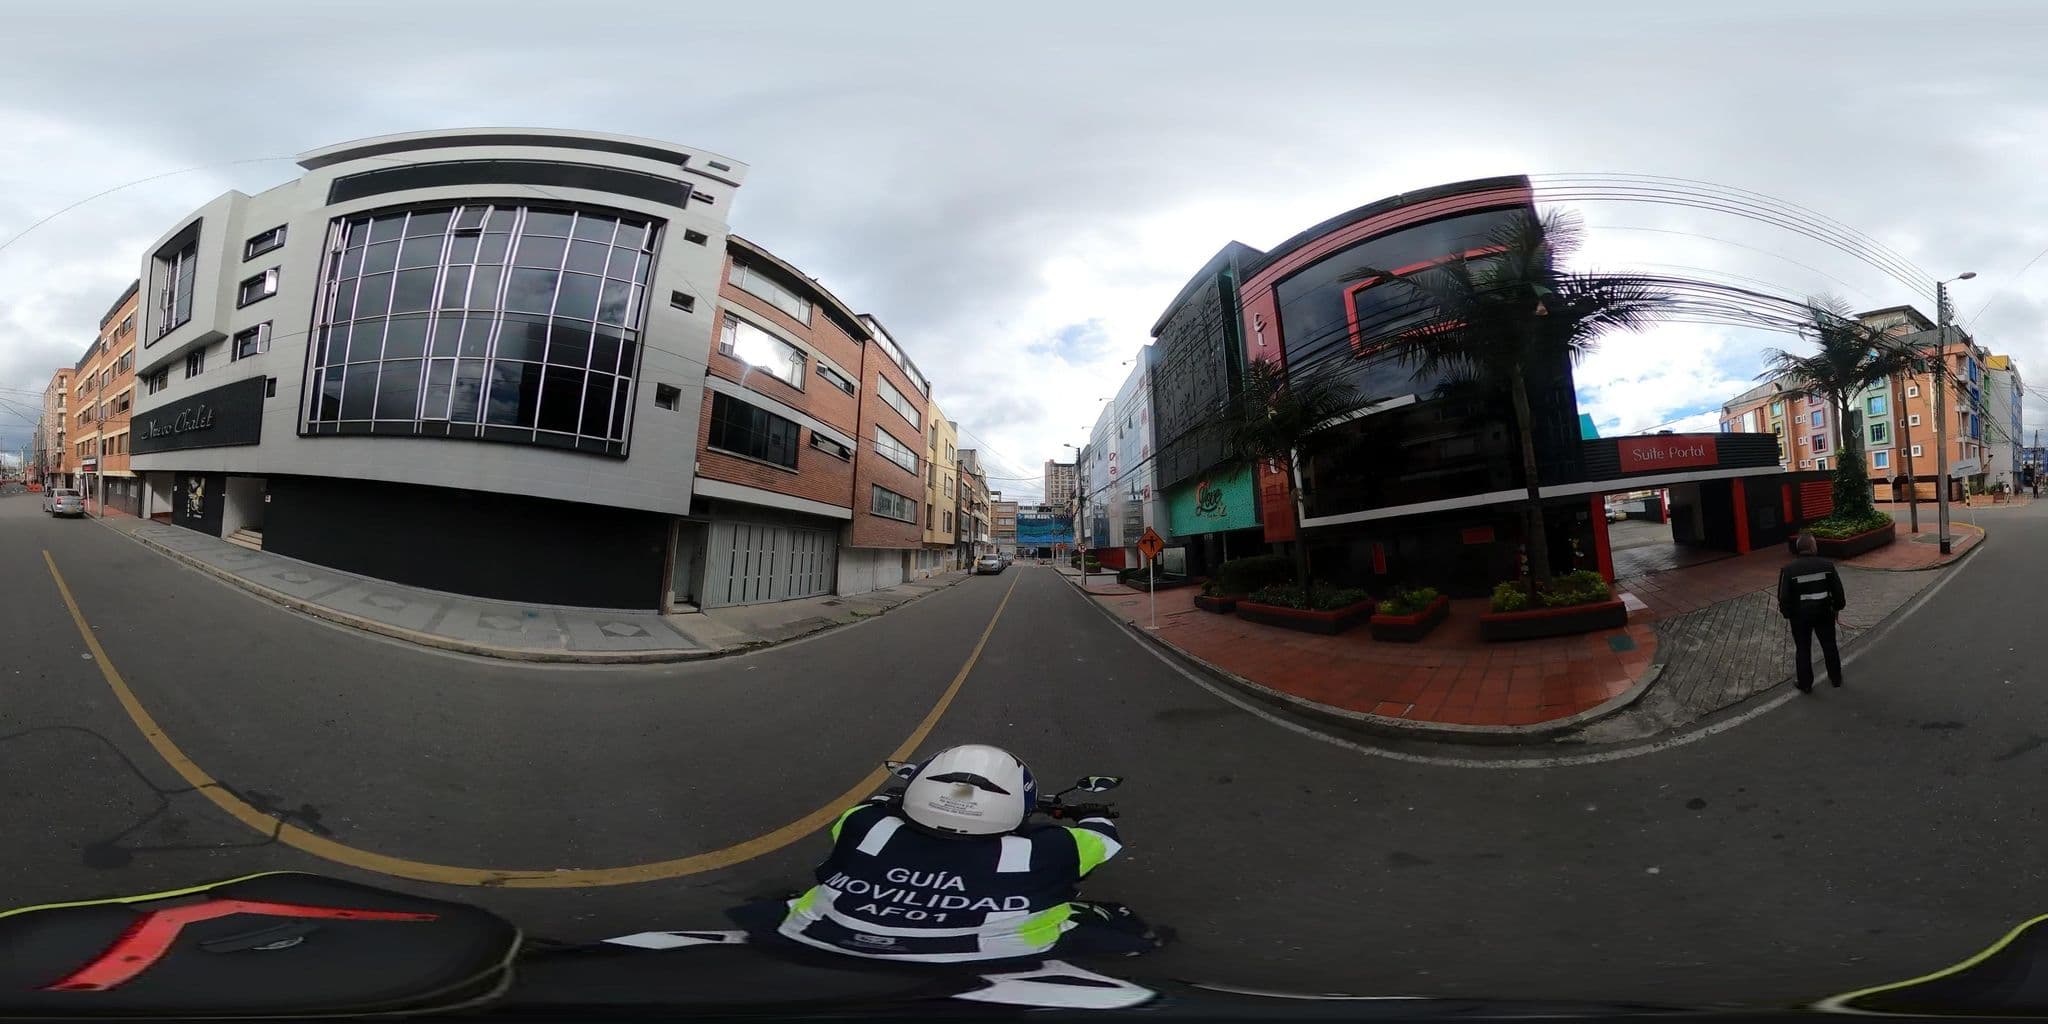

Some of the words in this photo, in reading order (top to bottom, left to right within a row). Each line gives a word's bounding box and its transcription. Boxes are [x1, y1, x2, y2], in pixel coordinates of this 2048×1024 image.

[174, 404, 215, 433] Chalet
[1632, 447, 1665, 462] Suite
[1669, 445, 1705, 459] Portal
[825, 871, 1031, 912] MOVILIDAD
[886, 867, 967, 892] GUÍA
[855, 903, 949, 923] AF01
